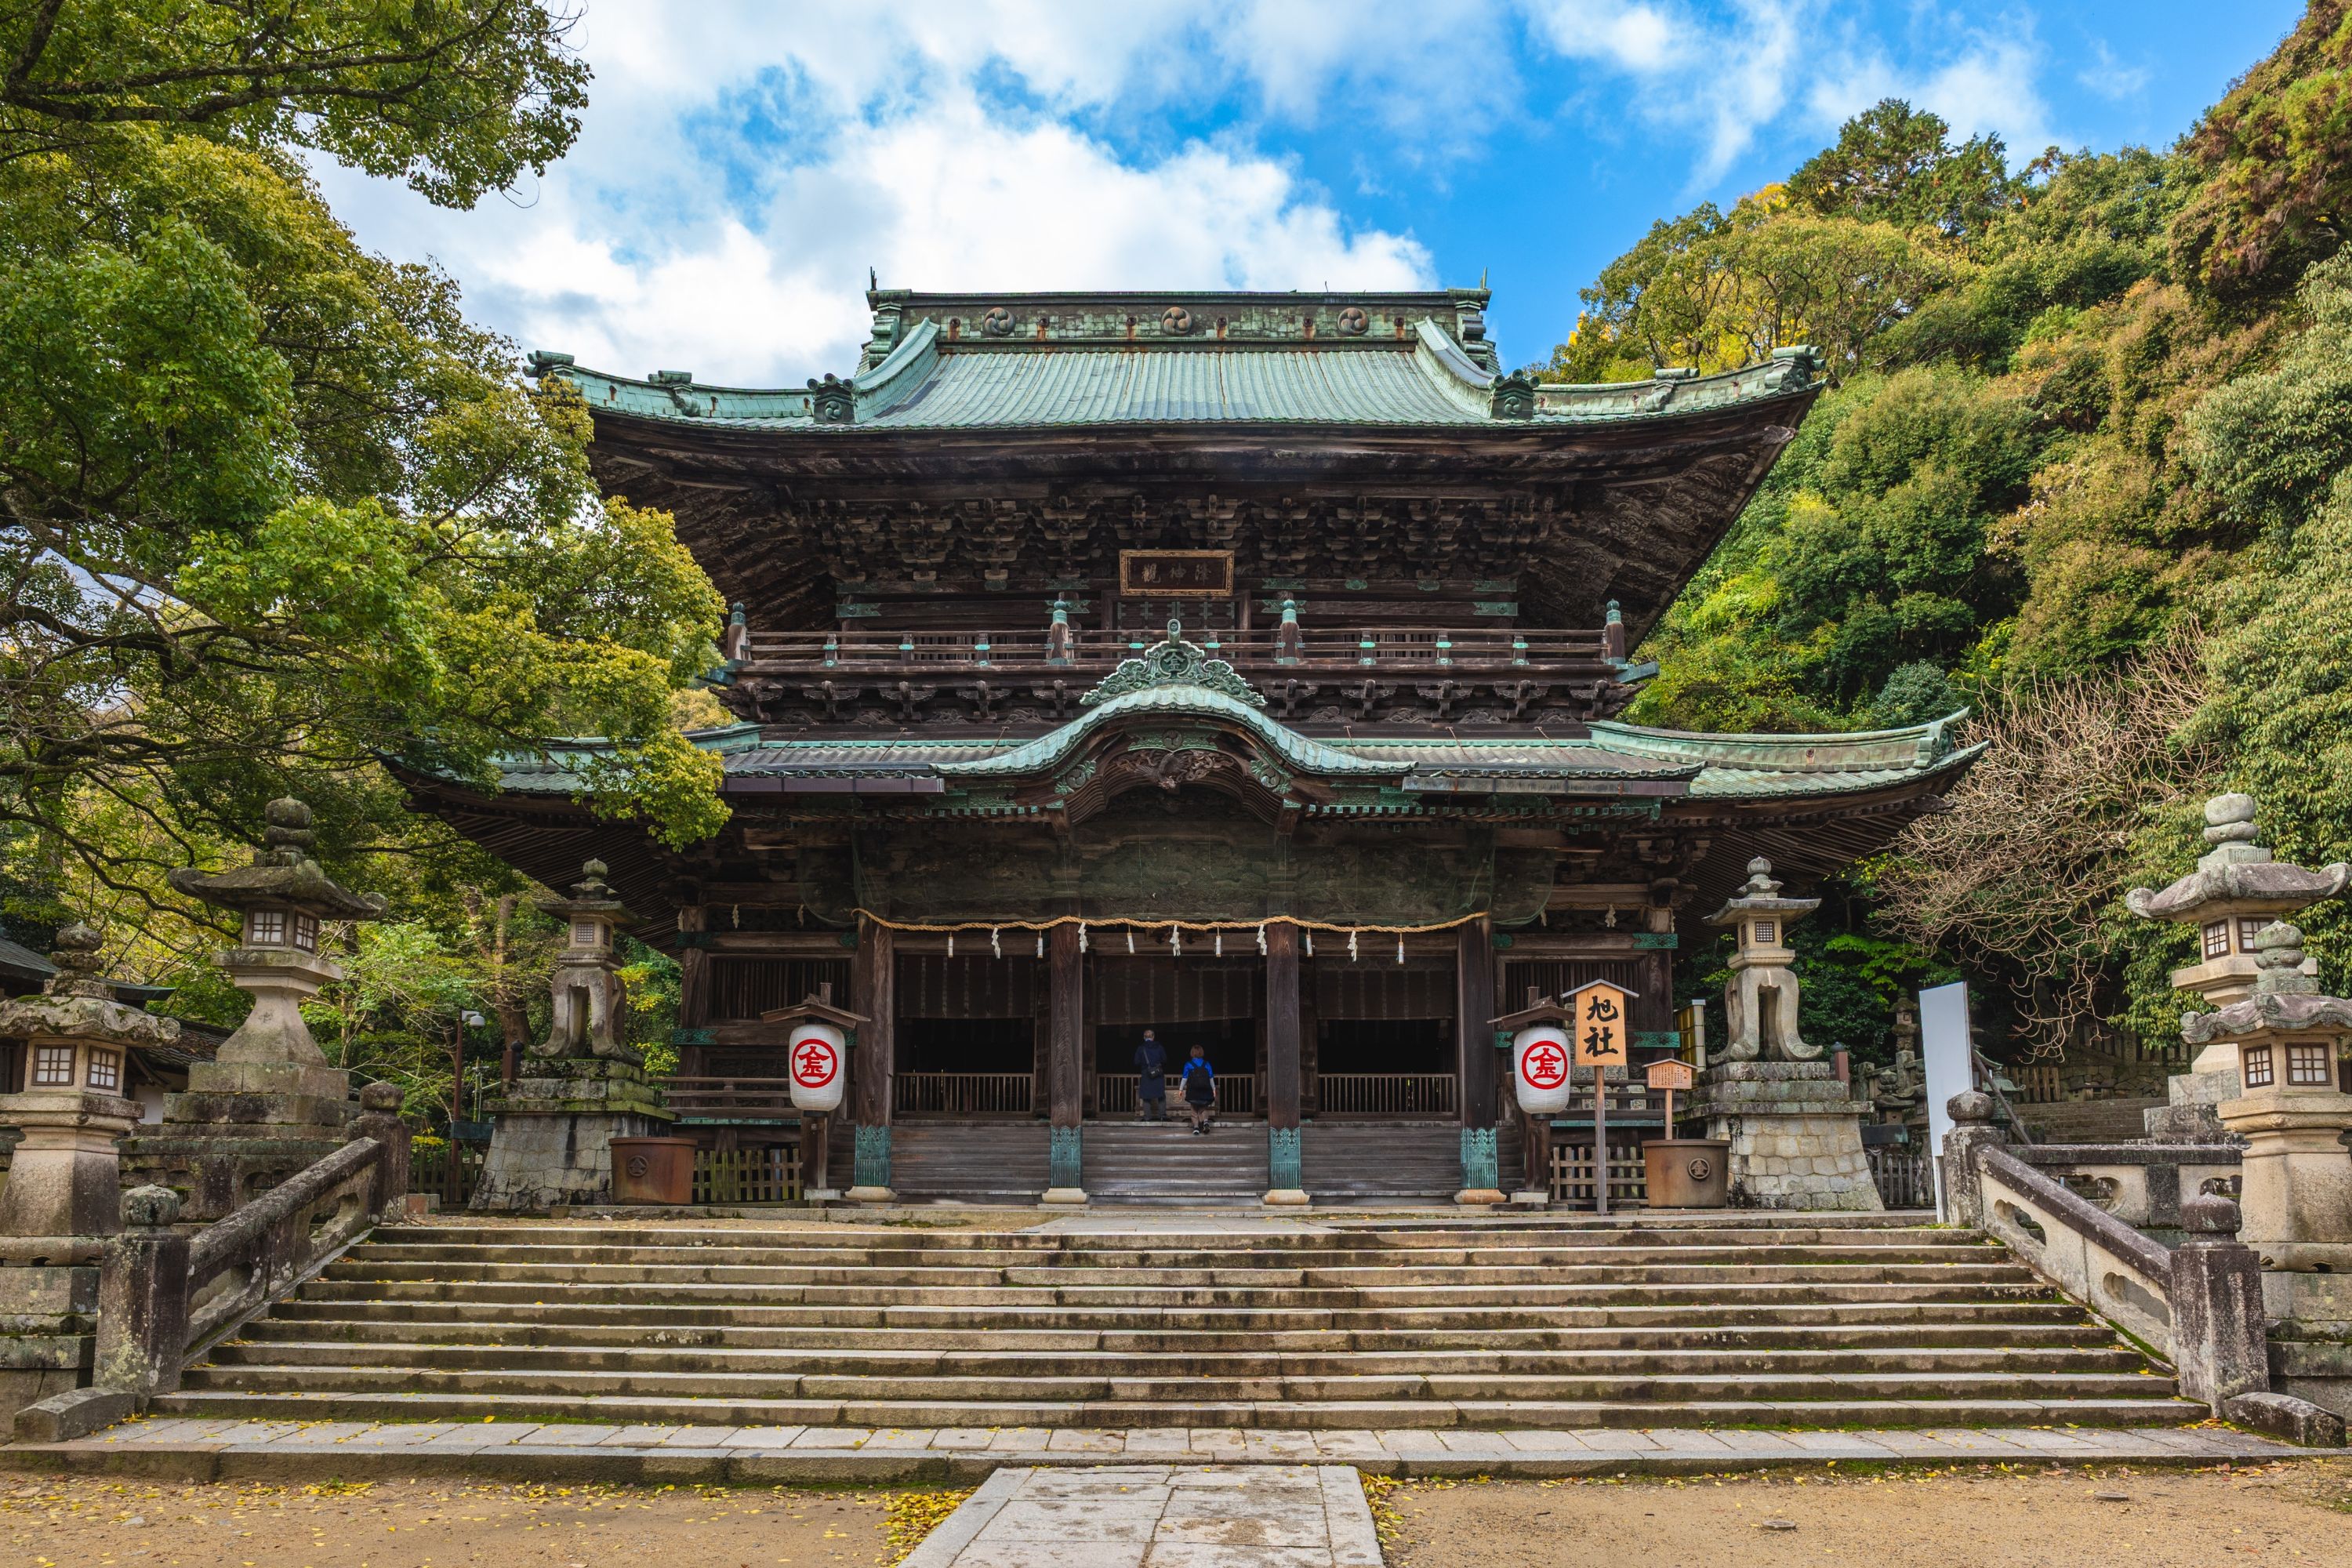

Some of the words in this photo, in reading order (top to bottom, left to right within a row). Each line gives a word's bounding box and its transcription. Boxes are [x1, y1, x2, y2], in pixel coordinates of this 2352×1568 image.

[1583, 995, 1619, 1058] 旭社
[797, 1045, 831, 1079] 金
[1529, 1047, 1563, 1080] 金
